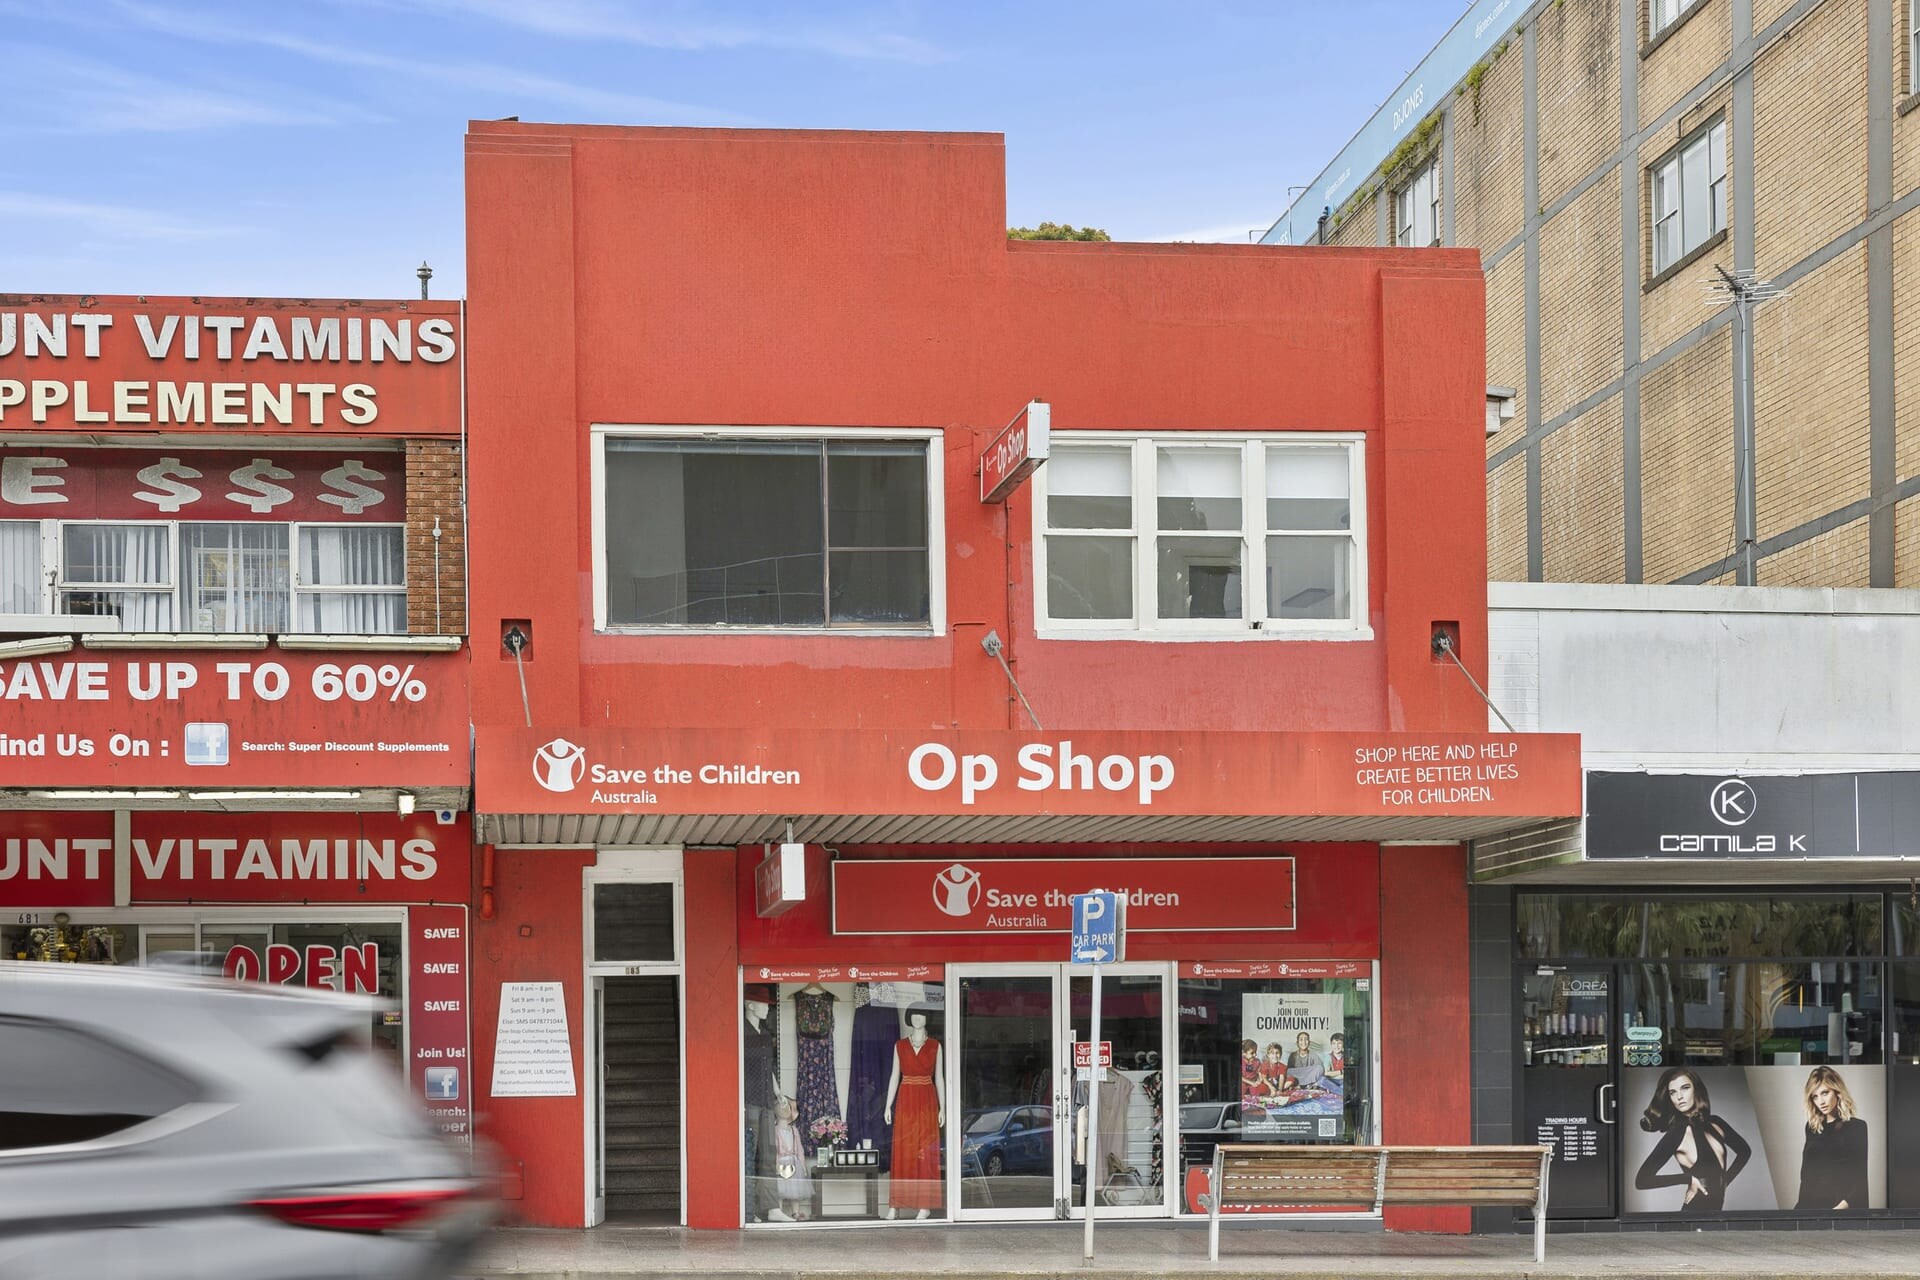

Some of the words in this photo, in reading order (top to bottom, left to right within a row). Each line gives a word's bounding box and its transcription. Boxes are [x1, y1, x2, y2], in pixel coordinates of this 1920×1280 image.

[134, 314, 456, 363] VITAMINS
[997, 443, 1007, 479] Op
[1008, 427, 1025, 464] Shop
[1, 456, 69, 504] E
[0, 662, 109, 700] AVE
[127, 662, 198, 700] UP
[216, 663, 290, 700] TO
[311, 664, 427, 702] 60%
[56, 734, 94, 756] Us
[109, 734, 149, 756] On
[241, 741, 285, 751] Search:
[288, 741, 321, 752] Super
[325, 741, 374, 751] Discount
[377, 742, 450, 752] Supplements
[1355, 747, 1397, 764] SHOP
[1402, 746, 1440, 761] HERE
[1445, 744, 1475, 760] AND
[1480, 743, 1518, 758] HELP
[591, 764, 647, 784] Save
[653, 764, 692, 784] the
[699, 764, 800, 785] Children
[908, 742, 998, 805] Op
[1017, 740, 1175, 805] Shop
[1356, 768, 1411, 785] CREATE
[1416, 765, 1472, 783] BETTER
[1477, 763, 1519, 780] LIVES
[591, 790, 657, 804] Australia
[1382, 789, 1413, 805] FOR
[1418, 786, 1495, 804] CHILDREN.
[1721, 790, 1745, 814] K
[1790, 834, 1807, 852] K
[132, 839, 438, 880] VITAMINS
[986, 889, 1037, 908] Save
[18, 913, 40, 924] 681
[986, 914, 1047, 928] Australia
[1083, 896, 1105, 934] P
[424, 928, 460, 938] SAVE!
[1073, 935, 1089, 947] CAR
[1092, 932, 1115, 946] PARK
[222, 942, 379, 994] OPEN
[423, 964, 459, 974] SAVE!
[424, 1001, 460, 1011] SAVE!
[1277, 1008, 1292, 1016] JOIN
[1294, 1008, 1309, 1016] OUR
[1256, 1016, 1329, 1030] COMMUNITY!
[417, 1048, 443, 1058] Join
[446, 1048, 466, 1058] Us!
[1077, 1055, 1109, 1065] CLOED
